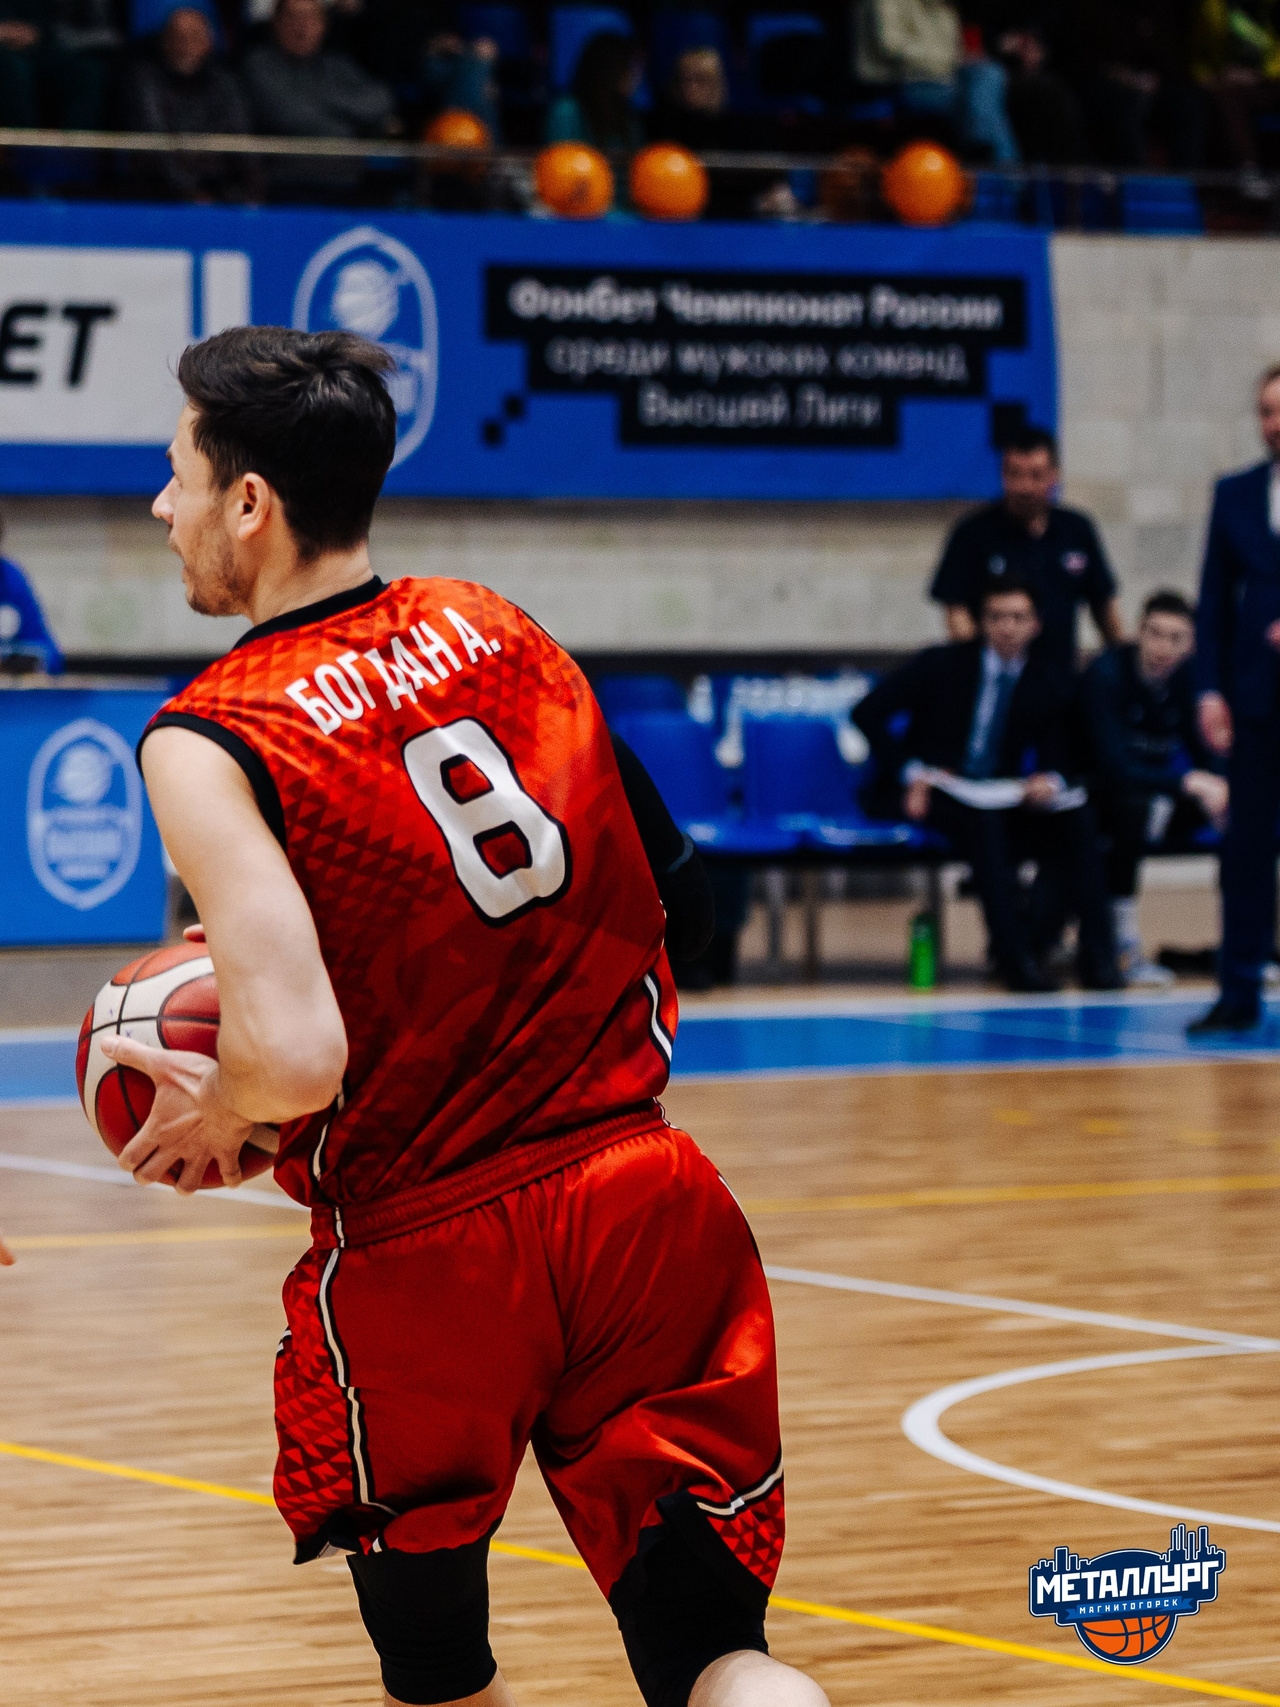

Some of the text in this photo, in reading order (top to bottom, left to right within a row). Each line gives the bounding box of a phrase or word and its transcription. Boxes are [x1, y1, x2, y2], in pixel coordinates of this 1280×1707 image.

[663, 283, 862, 326] Чемпионат
[870, 285, 1002, 329] России
[285, 606, 502, 736] БОГДАН А.
[403, 717, 568, 922] 8
